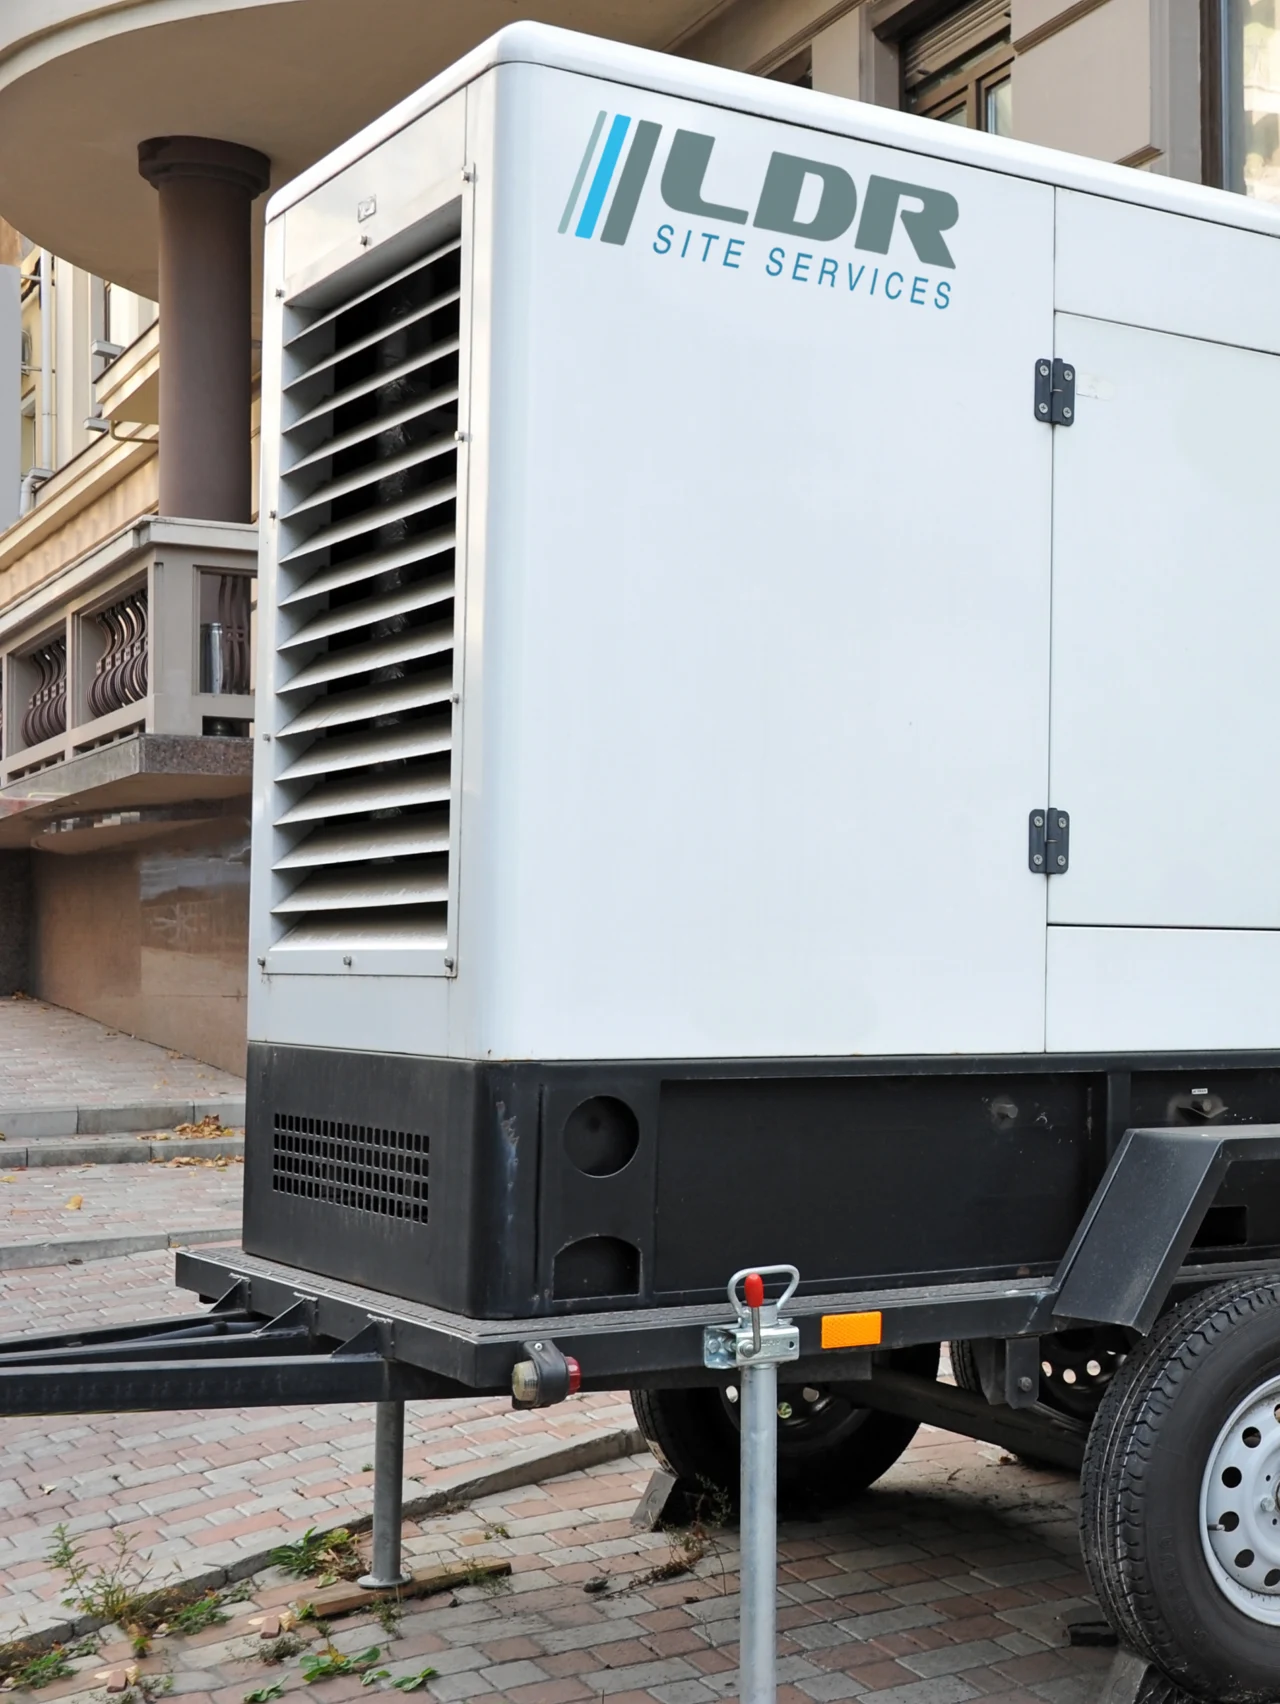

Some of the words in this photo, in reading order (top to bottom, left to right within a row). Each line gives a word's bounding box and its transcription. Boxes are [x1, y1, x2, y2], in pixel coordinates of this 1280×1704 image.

[660, 128, 960, 270] LDR
[653, 223, 746, 269] SITE
[765, 247, 952, 310] SERVICES
